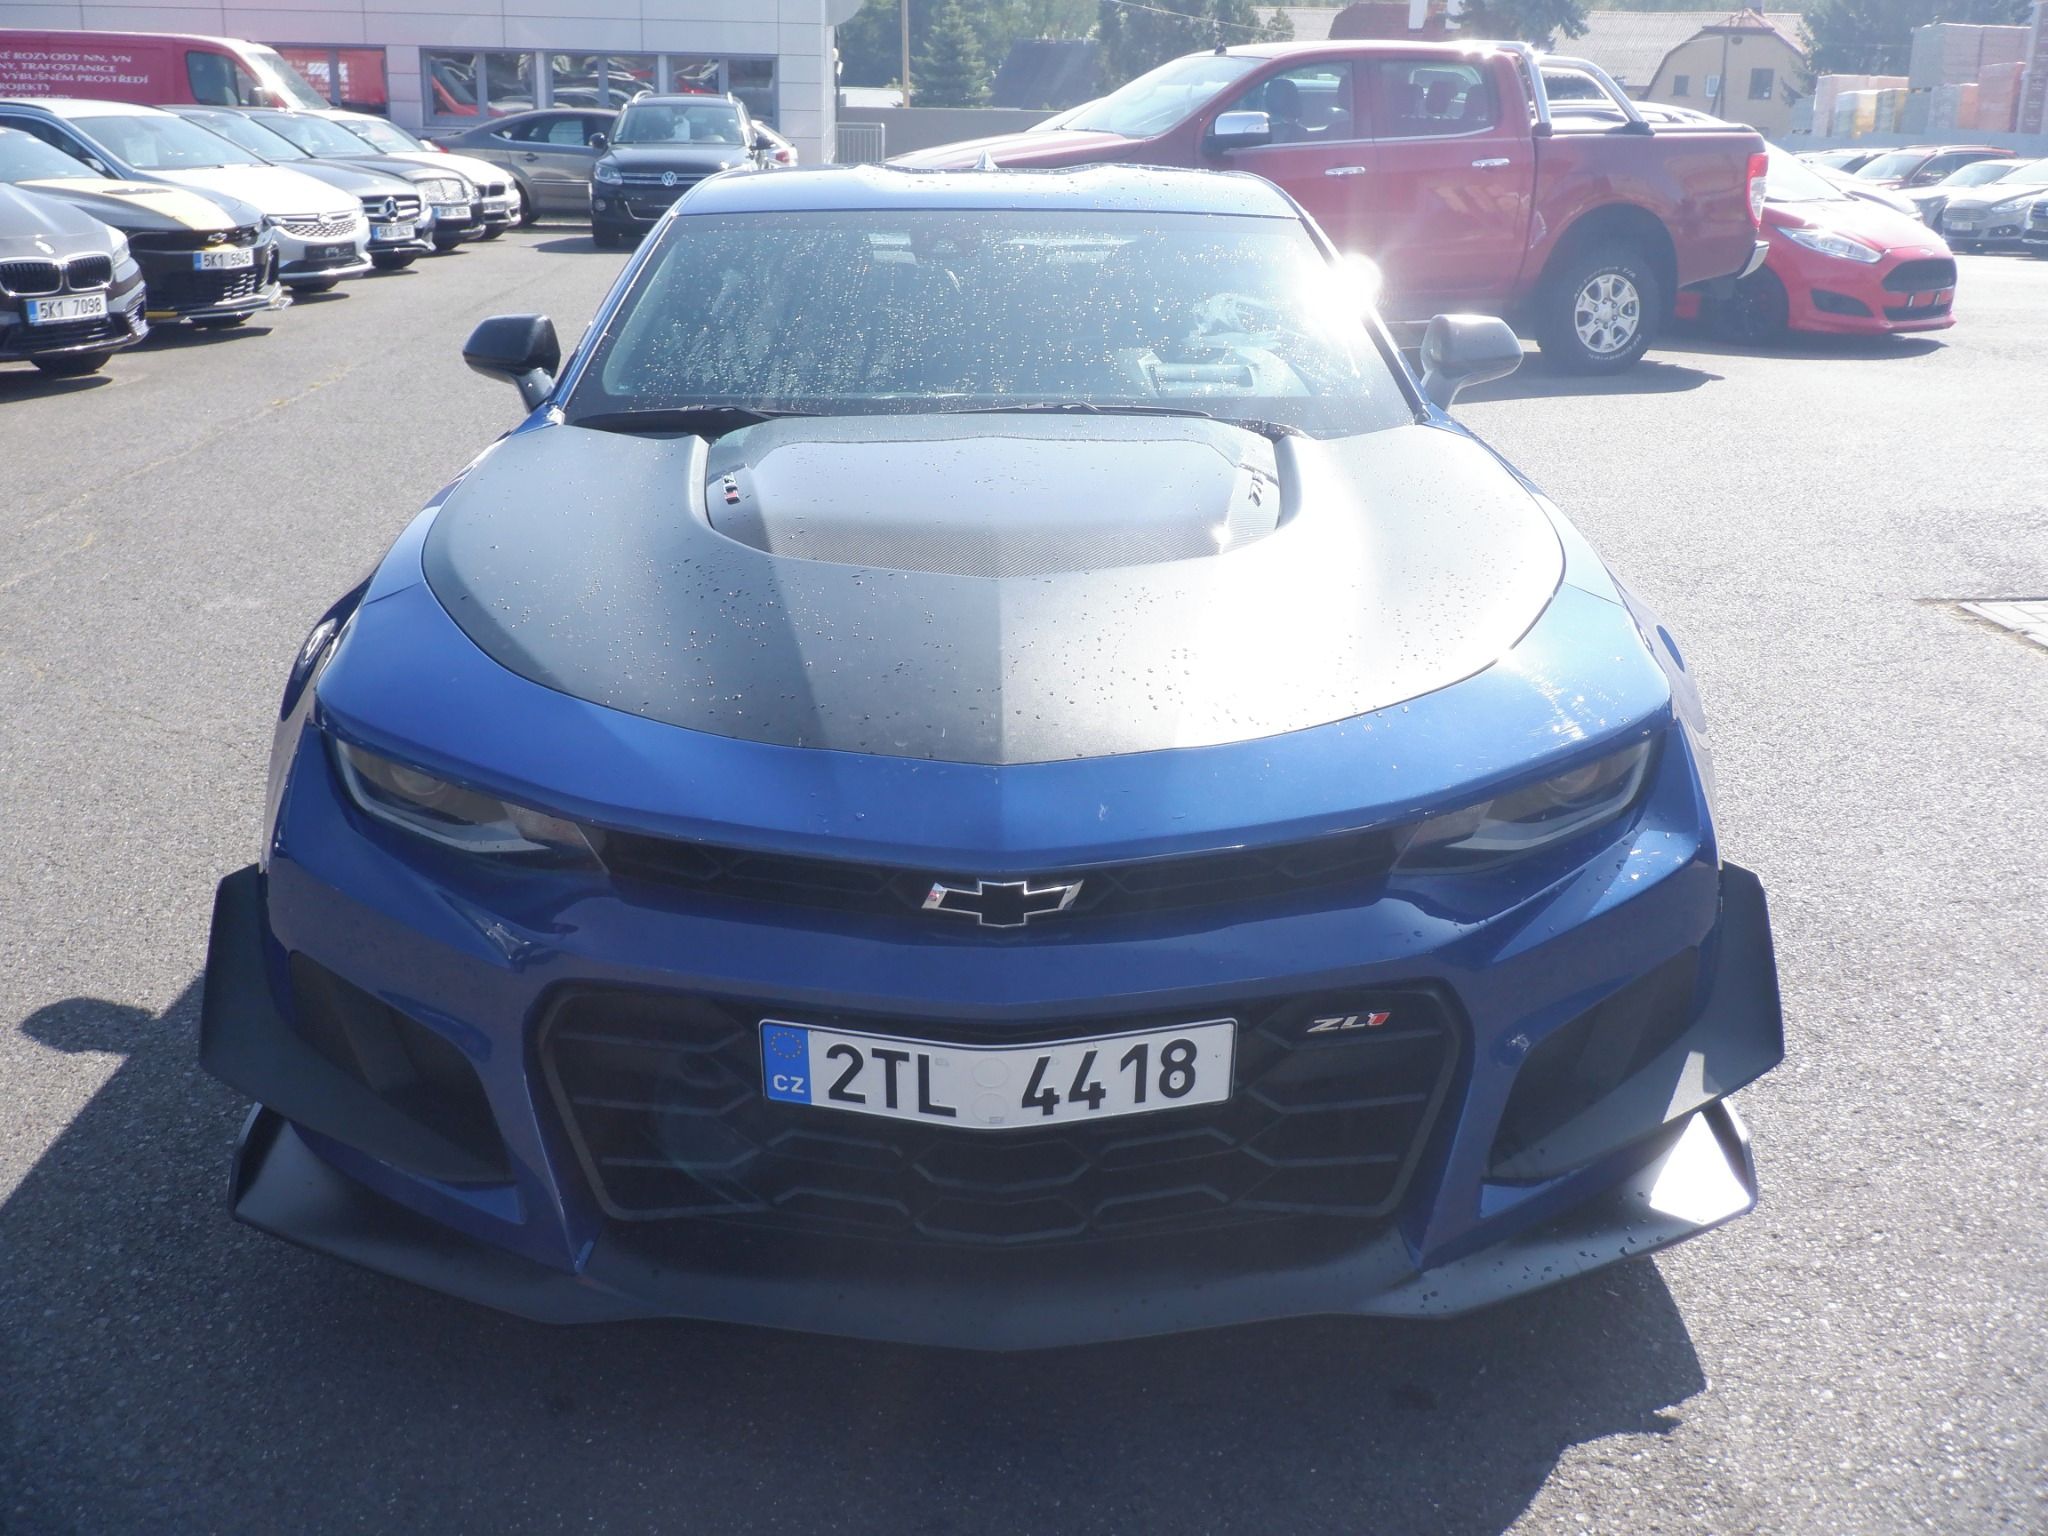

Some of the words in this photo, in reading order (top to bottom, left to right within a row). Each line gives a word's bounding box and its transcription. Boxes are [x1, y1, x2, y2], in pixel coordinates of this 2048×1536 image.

[13, 52, 80, 61] ROZVODY
[112, 55, 132, 63] VN
[21, 62, 117, 73] TRAFOSTANICE
[77, 74, 149, 84] PROSTŘEDÍ
[204, 253, 224, 268] 5K1
[40, 301, 64, 318] 5K1
[1307, 1012, 1391, 1033] ZL1
[773, 1074, 805, 1094] CZ
[826, 1043, 957, 1118] 2TL
[1021, 1038, 1198, 1116] 4418
